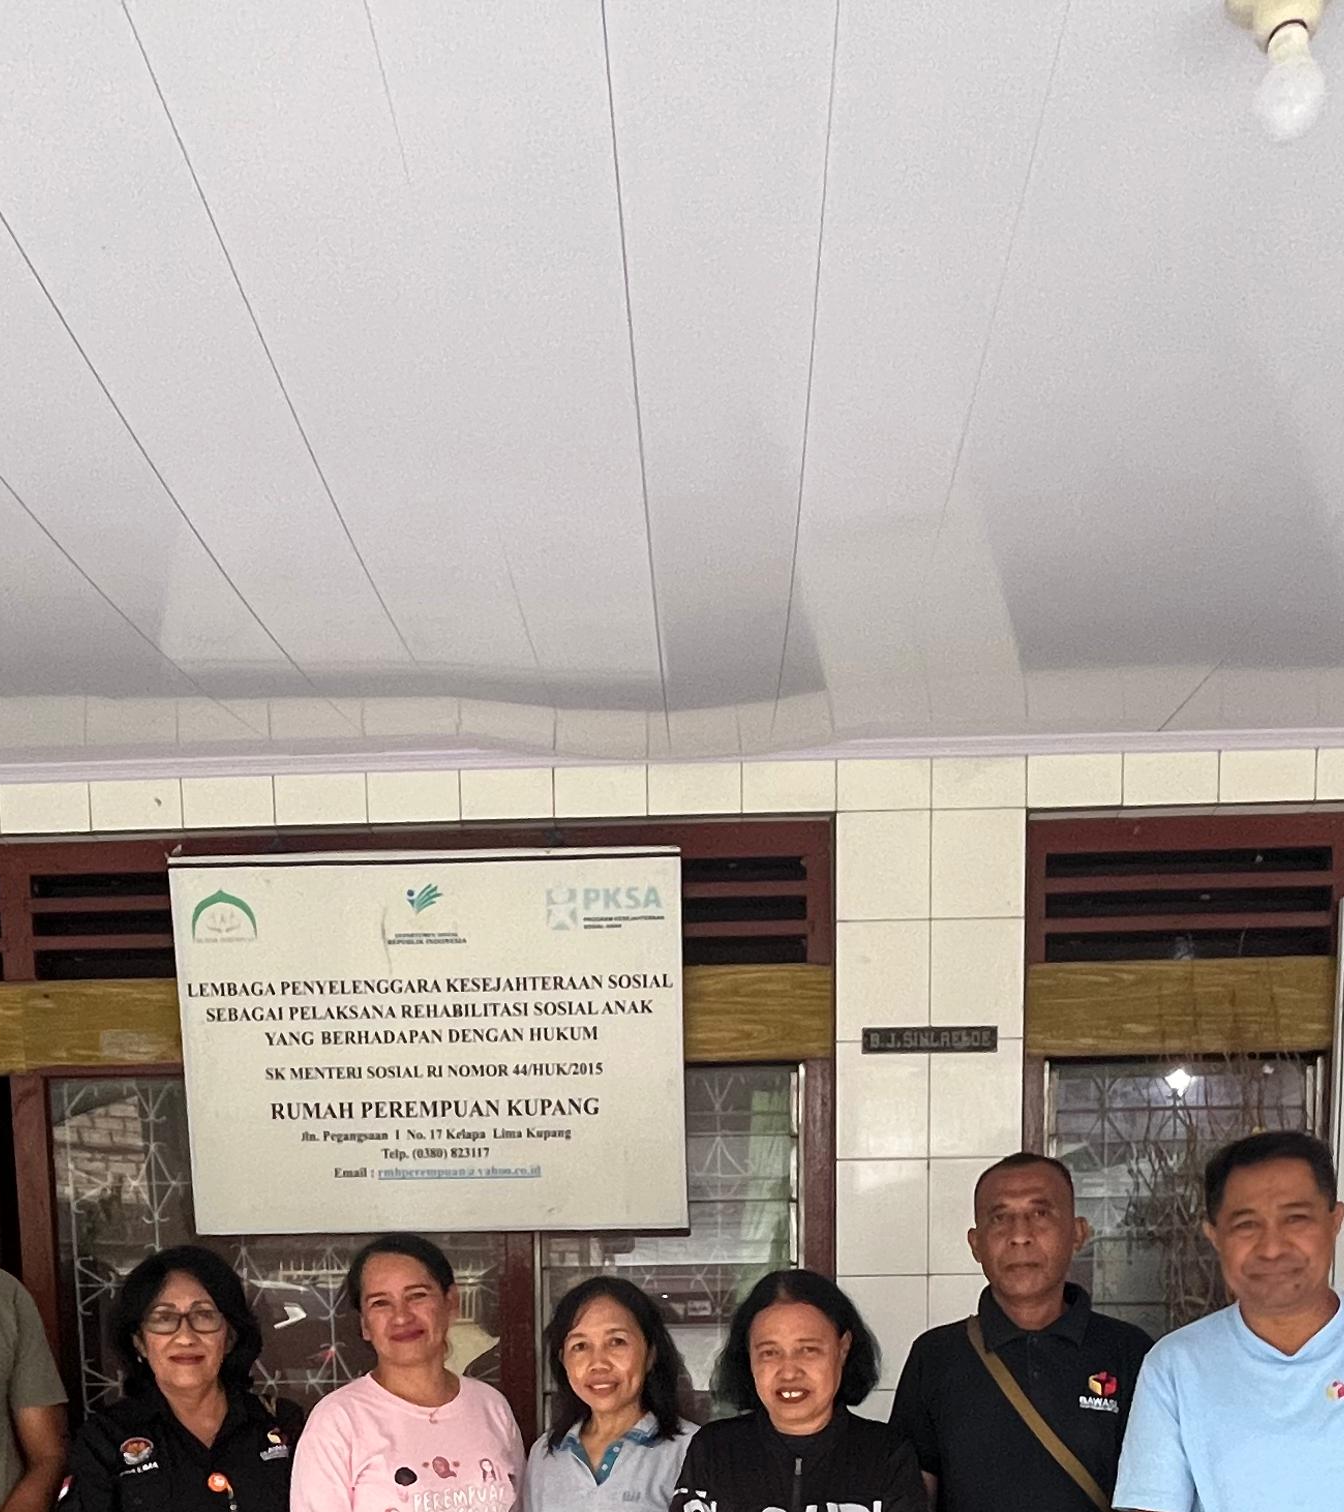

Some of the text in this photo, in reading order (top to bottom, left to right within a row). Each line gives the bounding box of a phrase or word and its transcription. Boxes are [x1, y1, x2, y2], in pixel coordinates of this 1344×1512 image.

[582, 886, 663, 909] PKSA
[187, 973, 673, 997] LEMBAGA PENYELENGGARA KESEJAHTERAAN SOSIAL
[206, 1000, 653, 1022] SEBAGAI PELAKSANA REHABILITASI SOSIAL ANAK
[265, 1026, 598, 1046] YANG BERHADAPAN DENGAN HUKUM
[265, 1062, 603, 1080] SK MENTERI SOSIAL RI NOMOR 44/HUK/2015
[271, 1097, 600, 1120] RUMAH PEREMPUAN KUPANG
[323, 1130, 388, 1143] Pegangsaan
[407, 1129, 426, 1140] No.
[430, 1129, 442, 1140] 17
[446, 1128, 486, 1141] Kelapa
[493, 1128, 522, 1139] Lima
[526, 1127, 572, 1141] Kupang
[381, 1147, 490, 1161] Telp. (0380) 823117
[334, 1167, 367, 1178] Email
